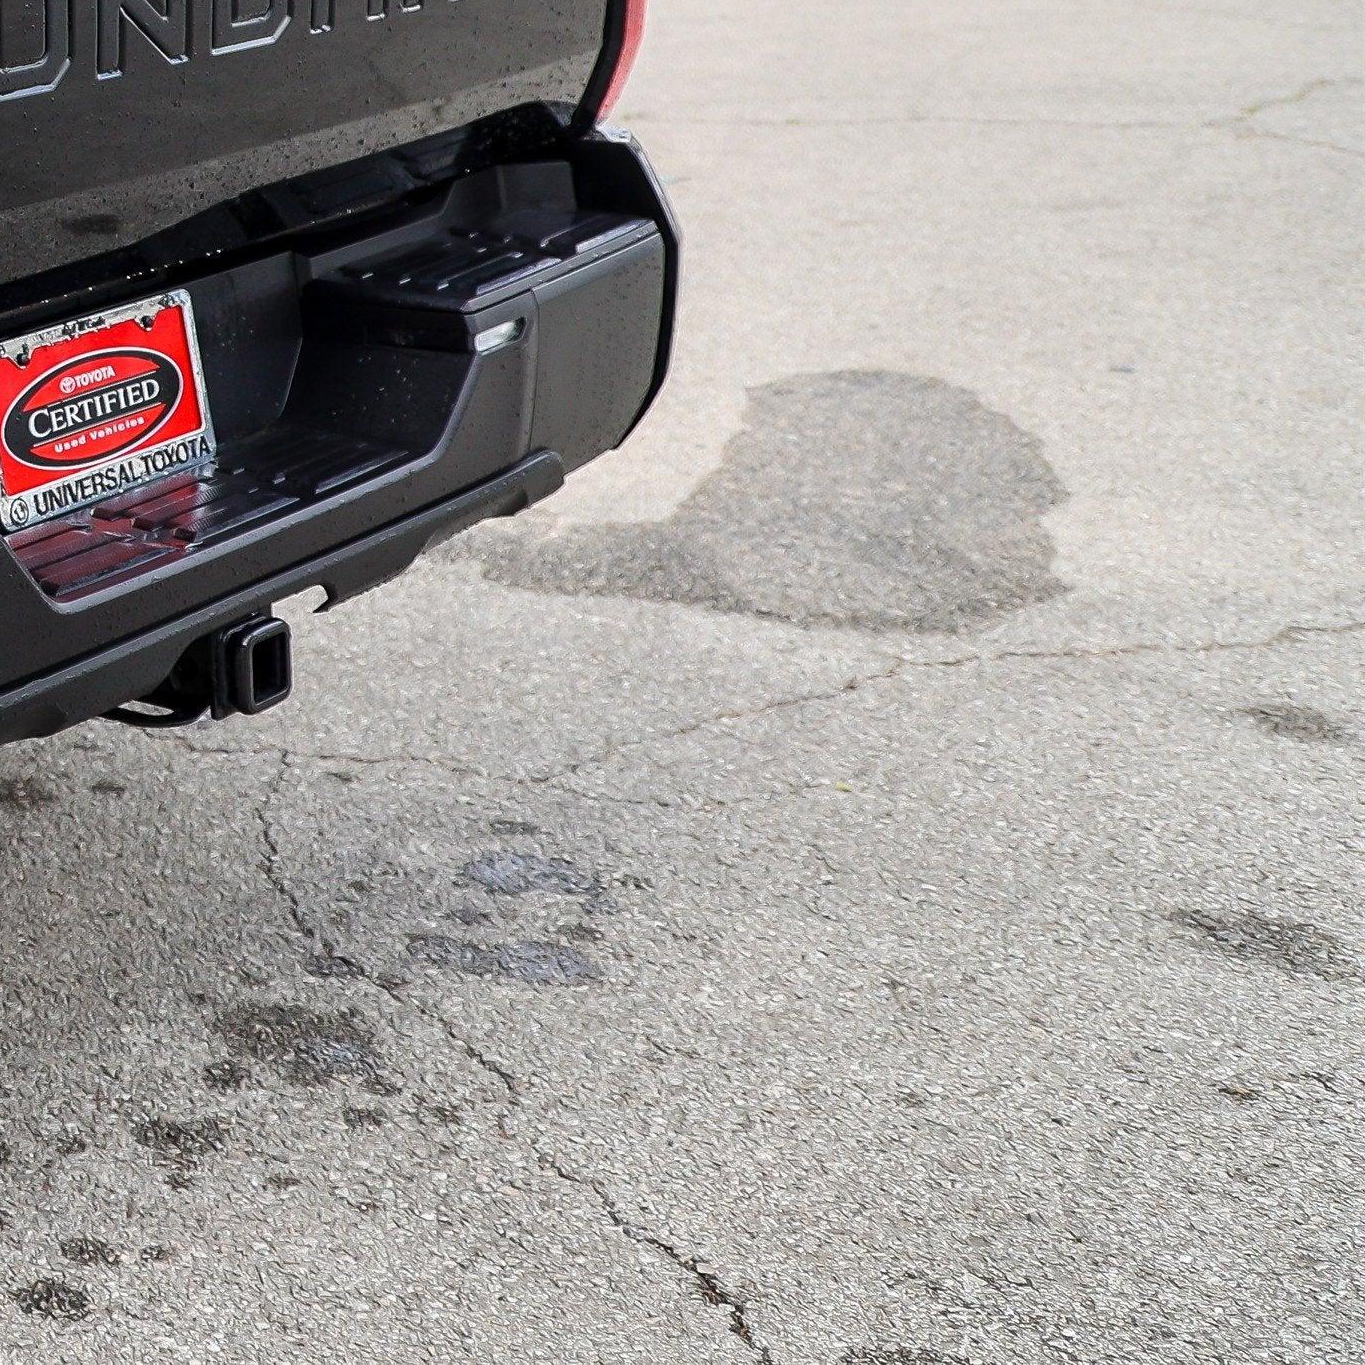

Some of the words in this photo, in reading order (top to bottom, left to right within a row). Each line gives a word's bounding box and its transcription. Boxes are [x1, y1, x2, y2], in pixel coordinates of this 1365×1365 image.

[75, 366, 116, 387] TOYOTA
[27, 378, 161, 438] CERTIFIED
[54, 435, 86, 453] Used
[90, 416, 145, 441] Vehicles
[33, 457, 141, 516] UNIVERSAL
[137, 435, 212, 478] TOYOTA
